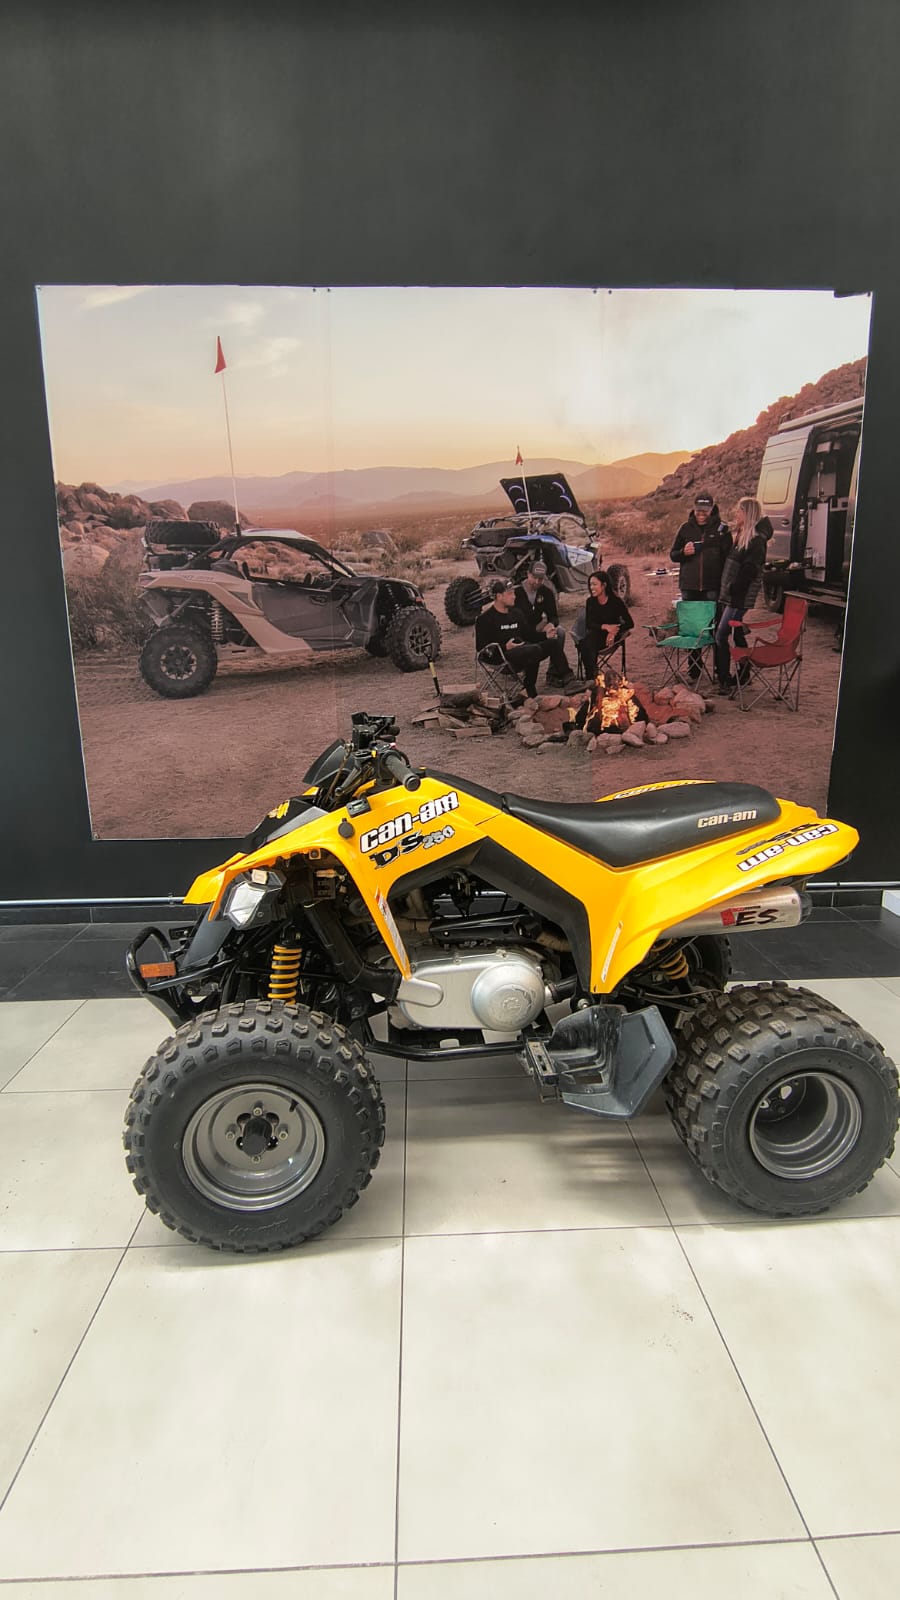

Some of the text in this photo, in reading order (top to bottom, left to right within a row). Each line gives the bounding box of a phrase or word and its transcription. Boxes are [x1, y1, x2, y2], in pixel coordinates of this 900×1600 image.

[360, 791, 459, 853] can-am
[697, 809, 758, 828] can-am
[736, 824, 840, 872] can-am
